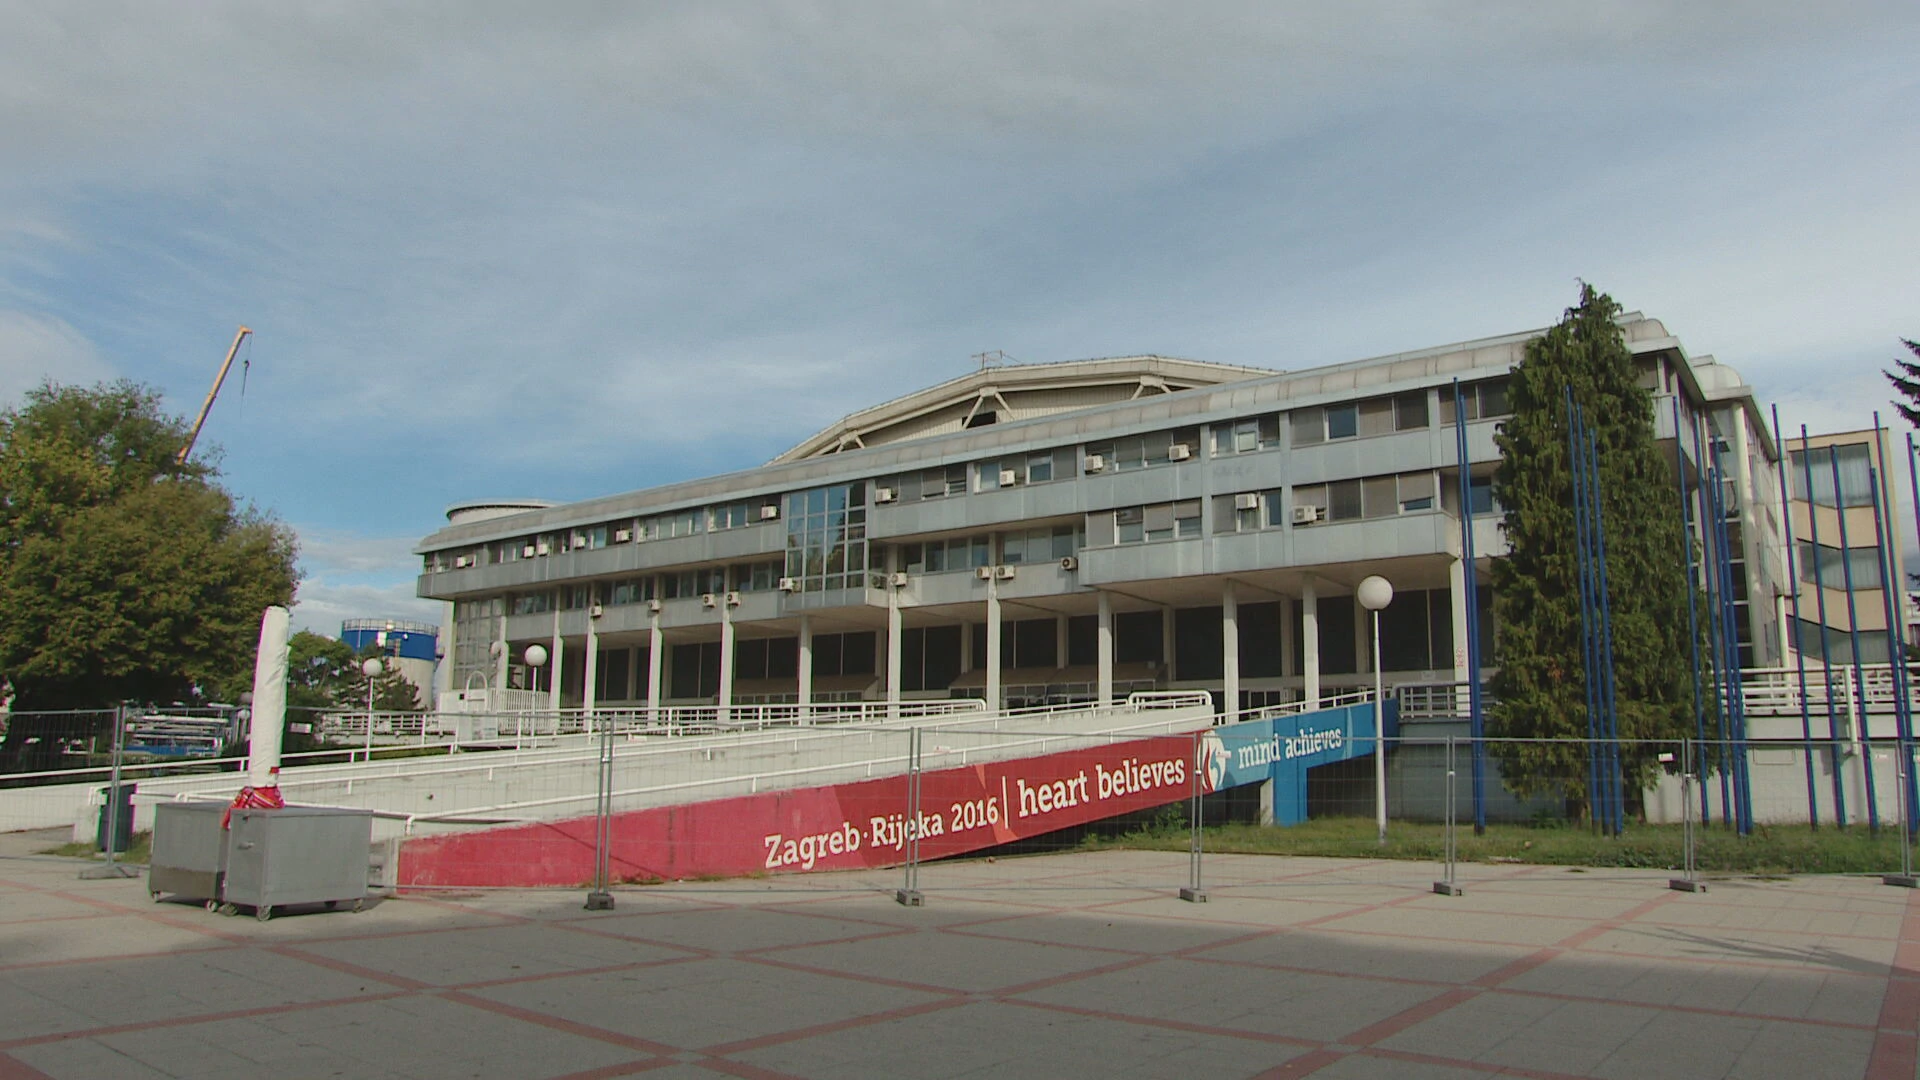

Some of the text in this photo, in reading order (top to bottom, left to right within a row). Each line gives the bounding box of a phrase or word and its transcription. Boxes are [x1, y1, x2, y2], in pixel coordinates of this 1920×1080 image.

[1238, 727, 1342, 770] mind achieves
[1017, 757, 1185, 818] heart believes
[764, 797, 999, 870] Zagreb Rijeka 2016
